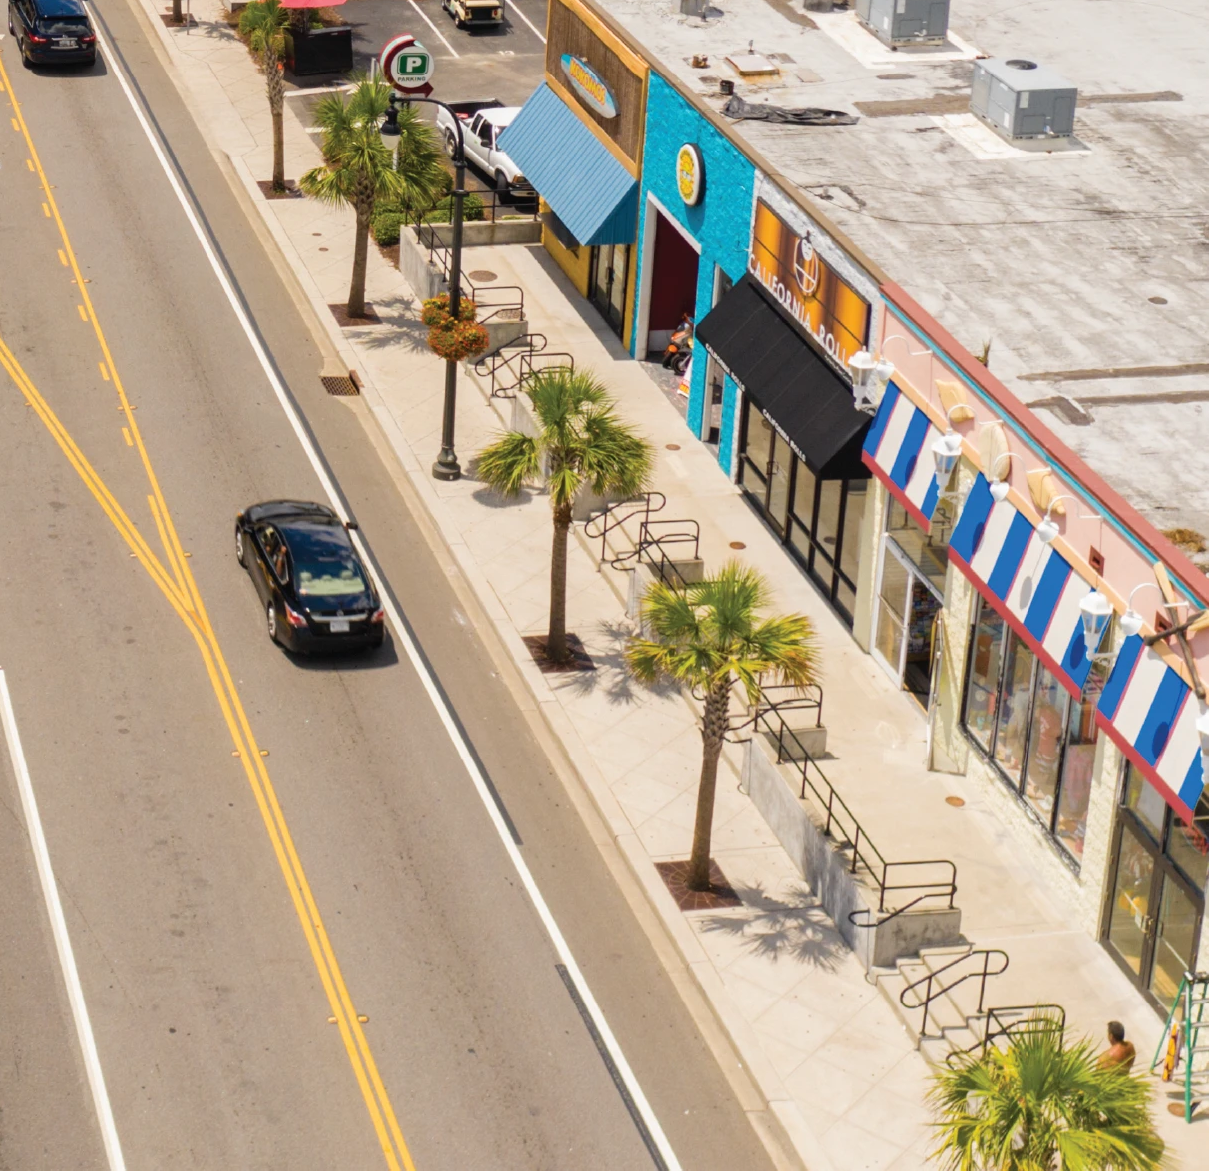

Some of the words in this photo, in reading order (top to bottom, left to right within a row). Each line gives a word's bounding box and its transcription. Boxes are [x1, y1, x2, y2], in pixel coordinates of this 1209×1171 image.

[406, 57, 422, 73] P
[748, 253, 813, 334] CALIFORNIA
[819, 324, 852, 378] ROLL
[762, 408, 790, 443] CALIFORNIA
[790, 440, 806, 462] ROLLS
